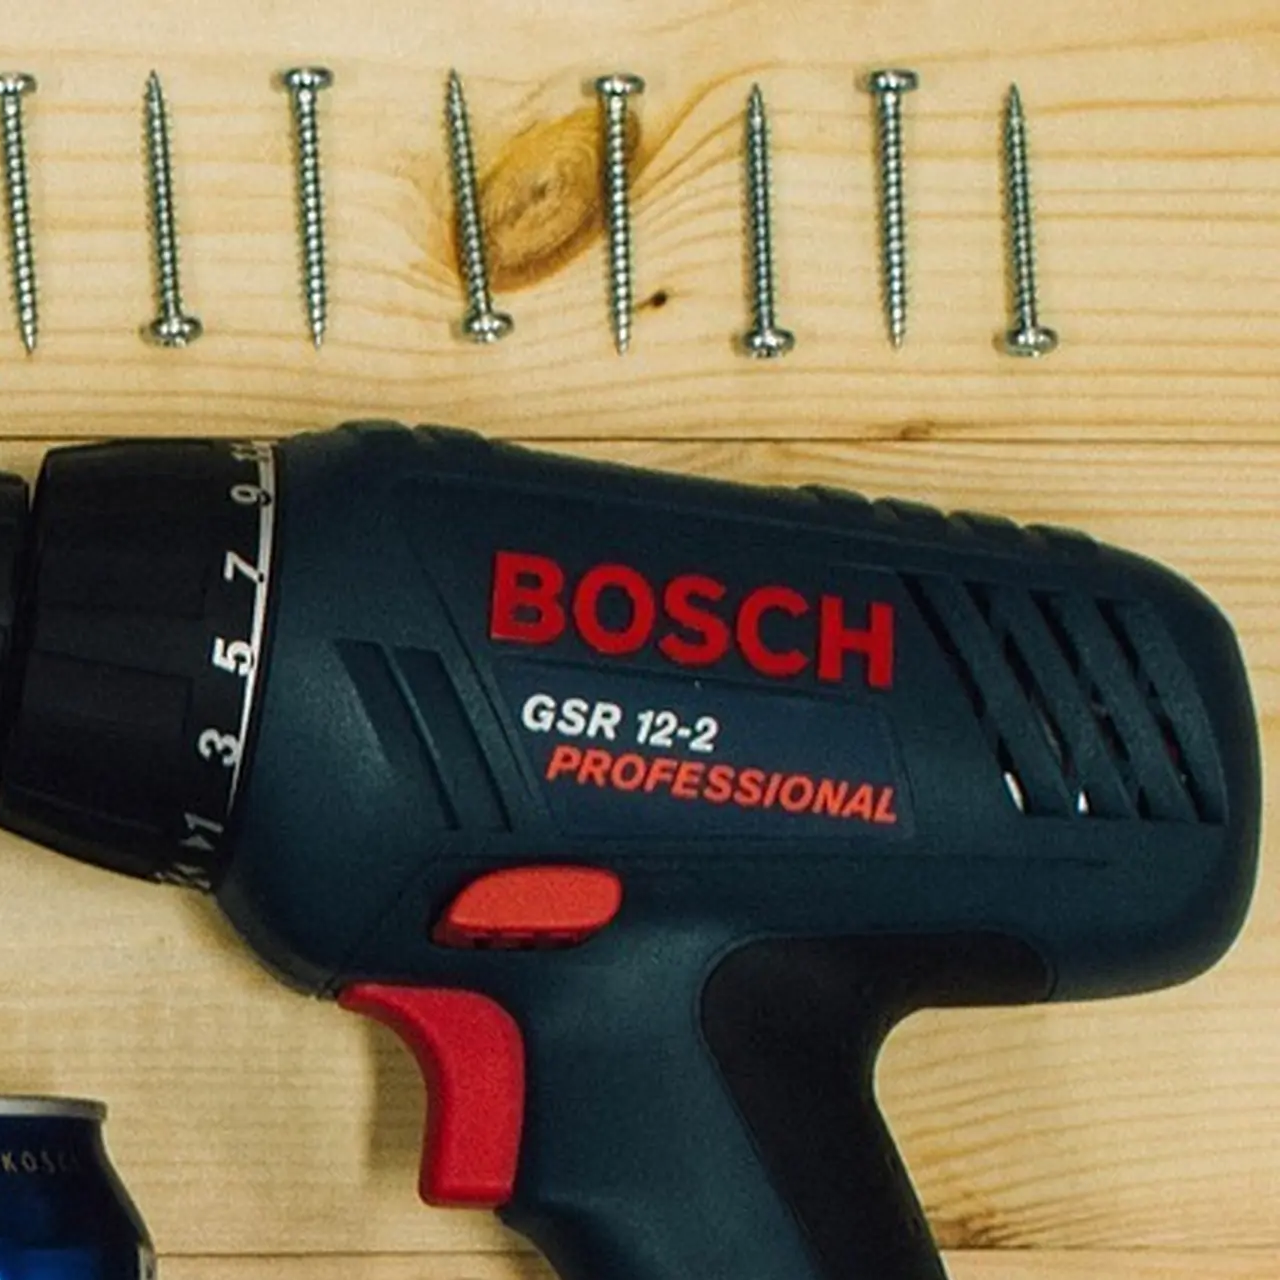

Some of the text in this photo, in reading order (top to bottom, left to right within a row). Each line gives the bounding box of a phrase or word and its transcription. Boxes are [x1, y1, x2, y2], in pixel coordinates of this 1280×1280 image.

[224, 550, 266, 584] 7
[490, 550, 896, 692] BOSCH
[212, 637, 256, 677] 5
[198, 728, 239, 768] 3
[521, 692, 721, 754] GSR 12-2
[545, 742, 899, 825] PROFESSIONAL
